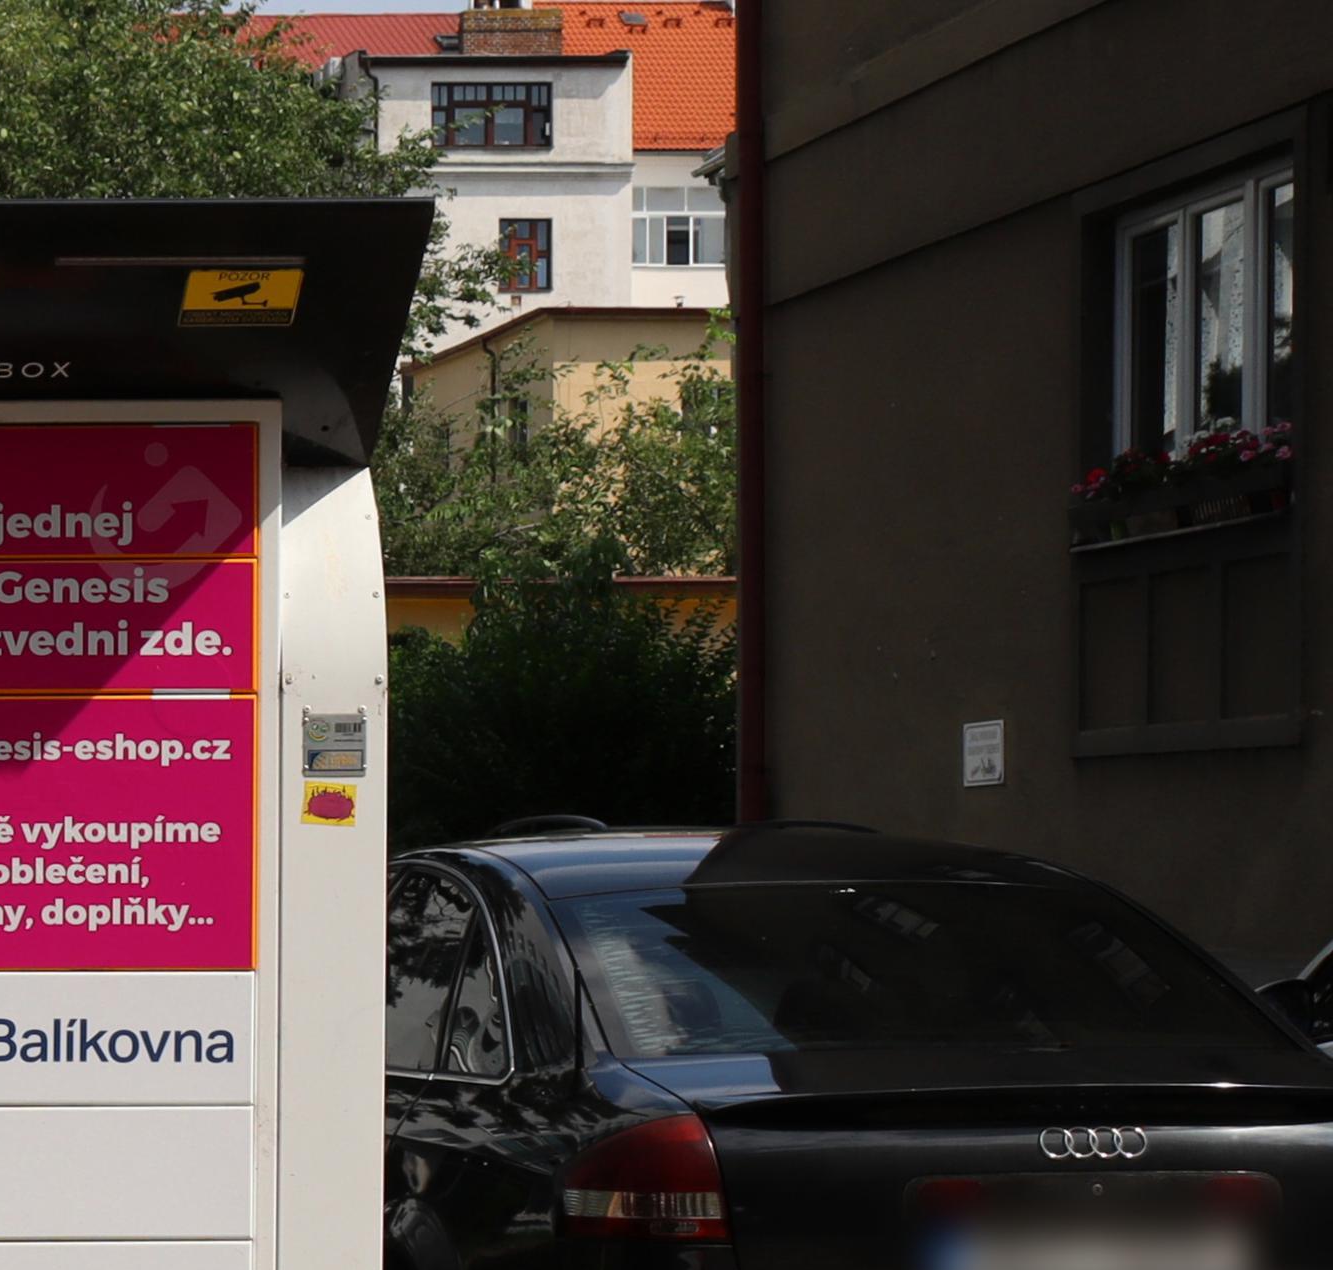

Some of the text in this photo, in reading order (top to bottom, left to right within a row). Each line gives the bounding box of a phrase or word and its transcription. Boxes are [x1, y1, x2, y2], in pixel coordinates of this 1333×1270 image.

[218, 271, 271, 281] POZOR
[139, 622, 233, 658] zde.
[18, 817, 222, 852] vykoupíme
[41, 897, 215, 934] doplňky...
